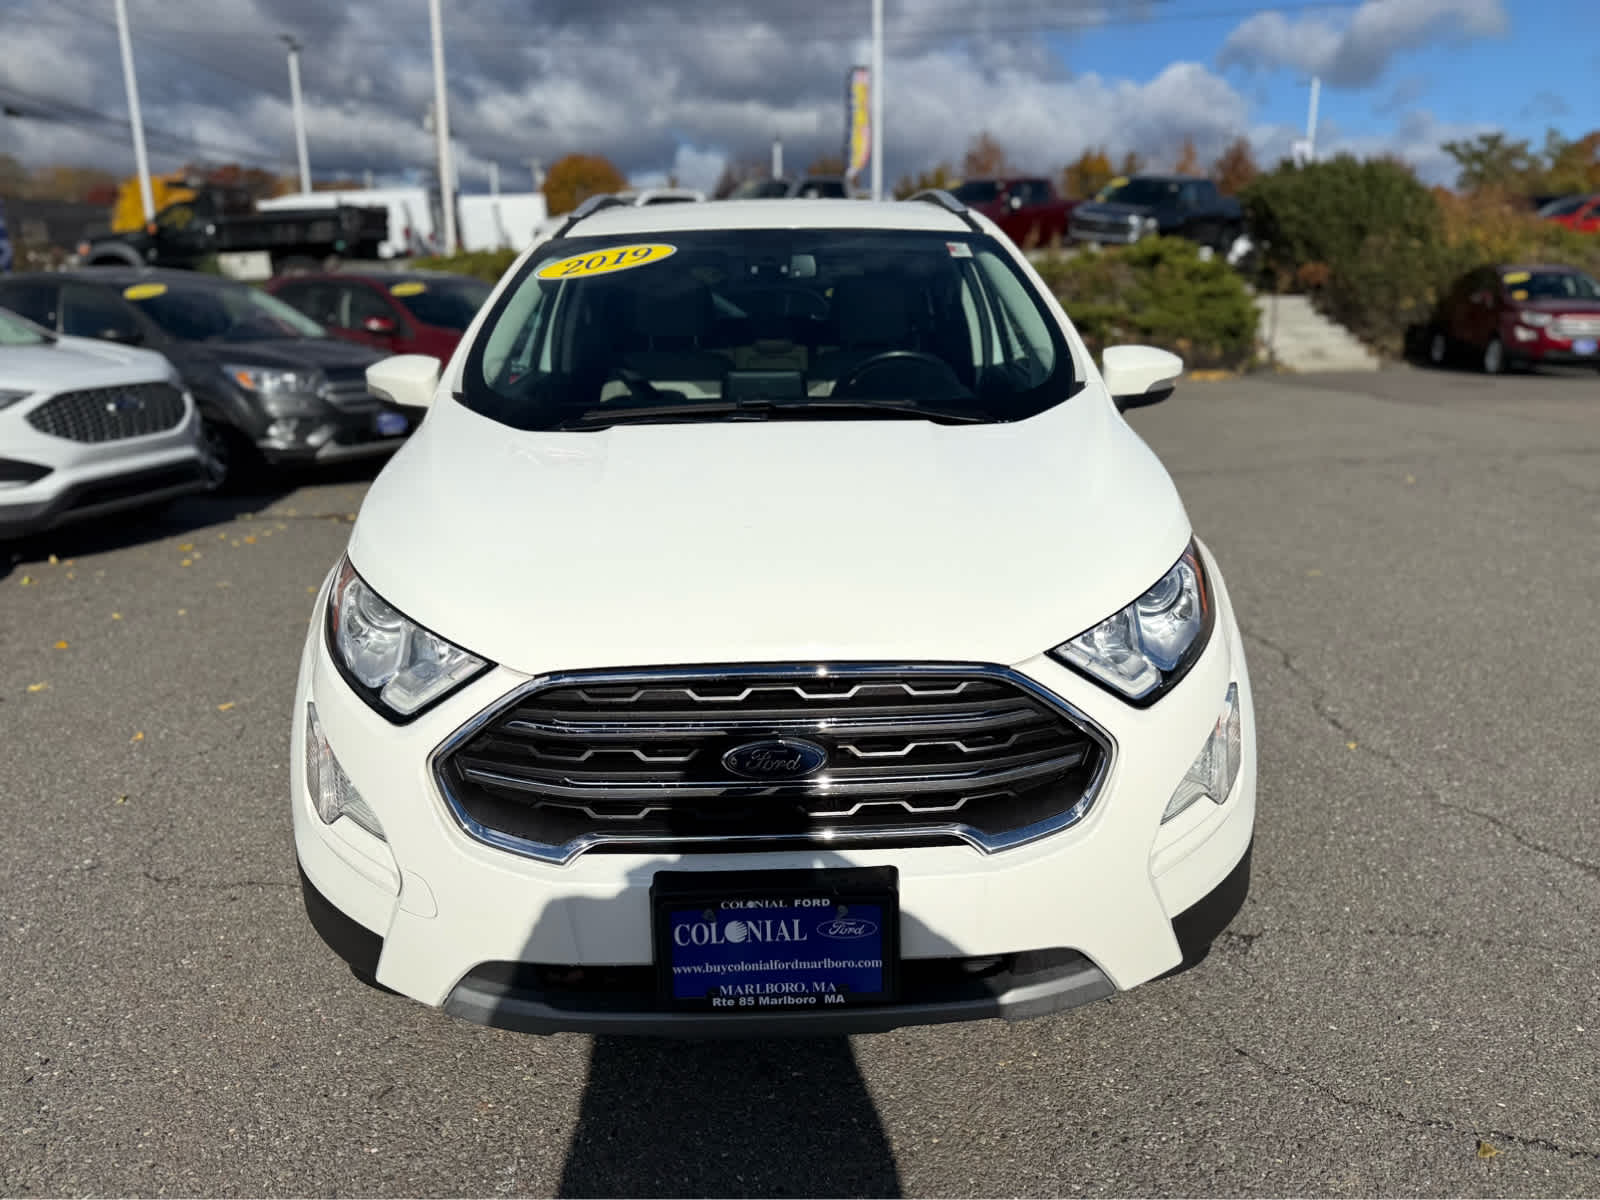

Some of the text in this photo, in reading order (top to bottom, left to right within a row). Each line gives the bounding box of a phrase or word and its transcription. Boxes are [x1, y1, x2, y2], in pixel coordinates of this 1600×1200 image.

[561, 247, 653, 276] 2019
[745, 748, 801, 770] Ford
[720, 898, 830, 910] COLONIAL FORD
[828, 920, 866, 936] Ford
[672, 958, 883, 976] www.buycolonialfordmarlboro.com
[812, 981, 837, 992] MA
[712, 993, 846, 1007] Rte 85 Marlboro MA
